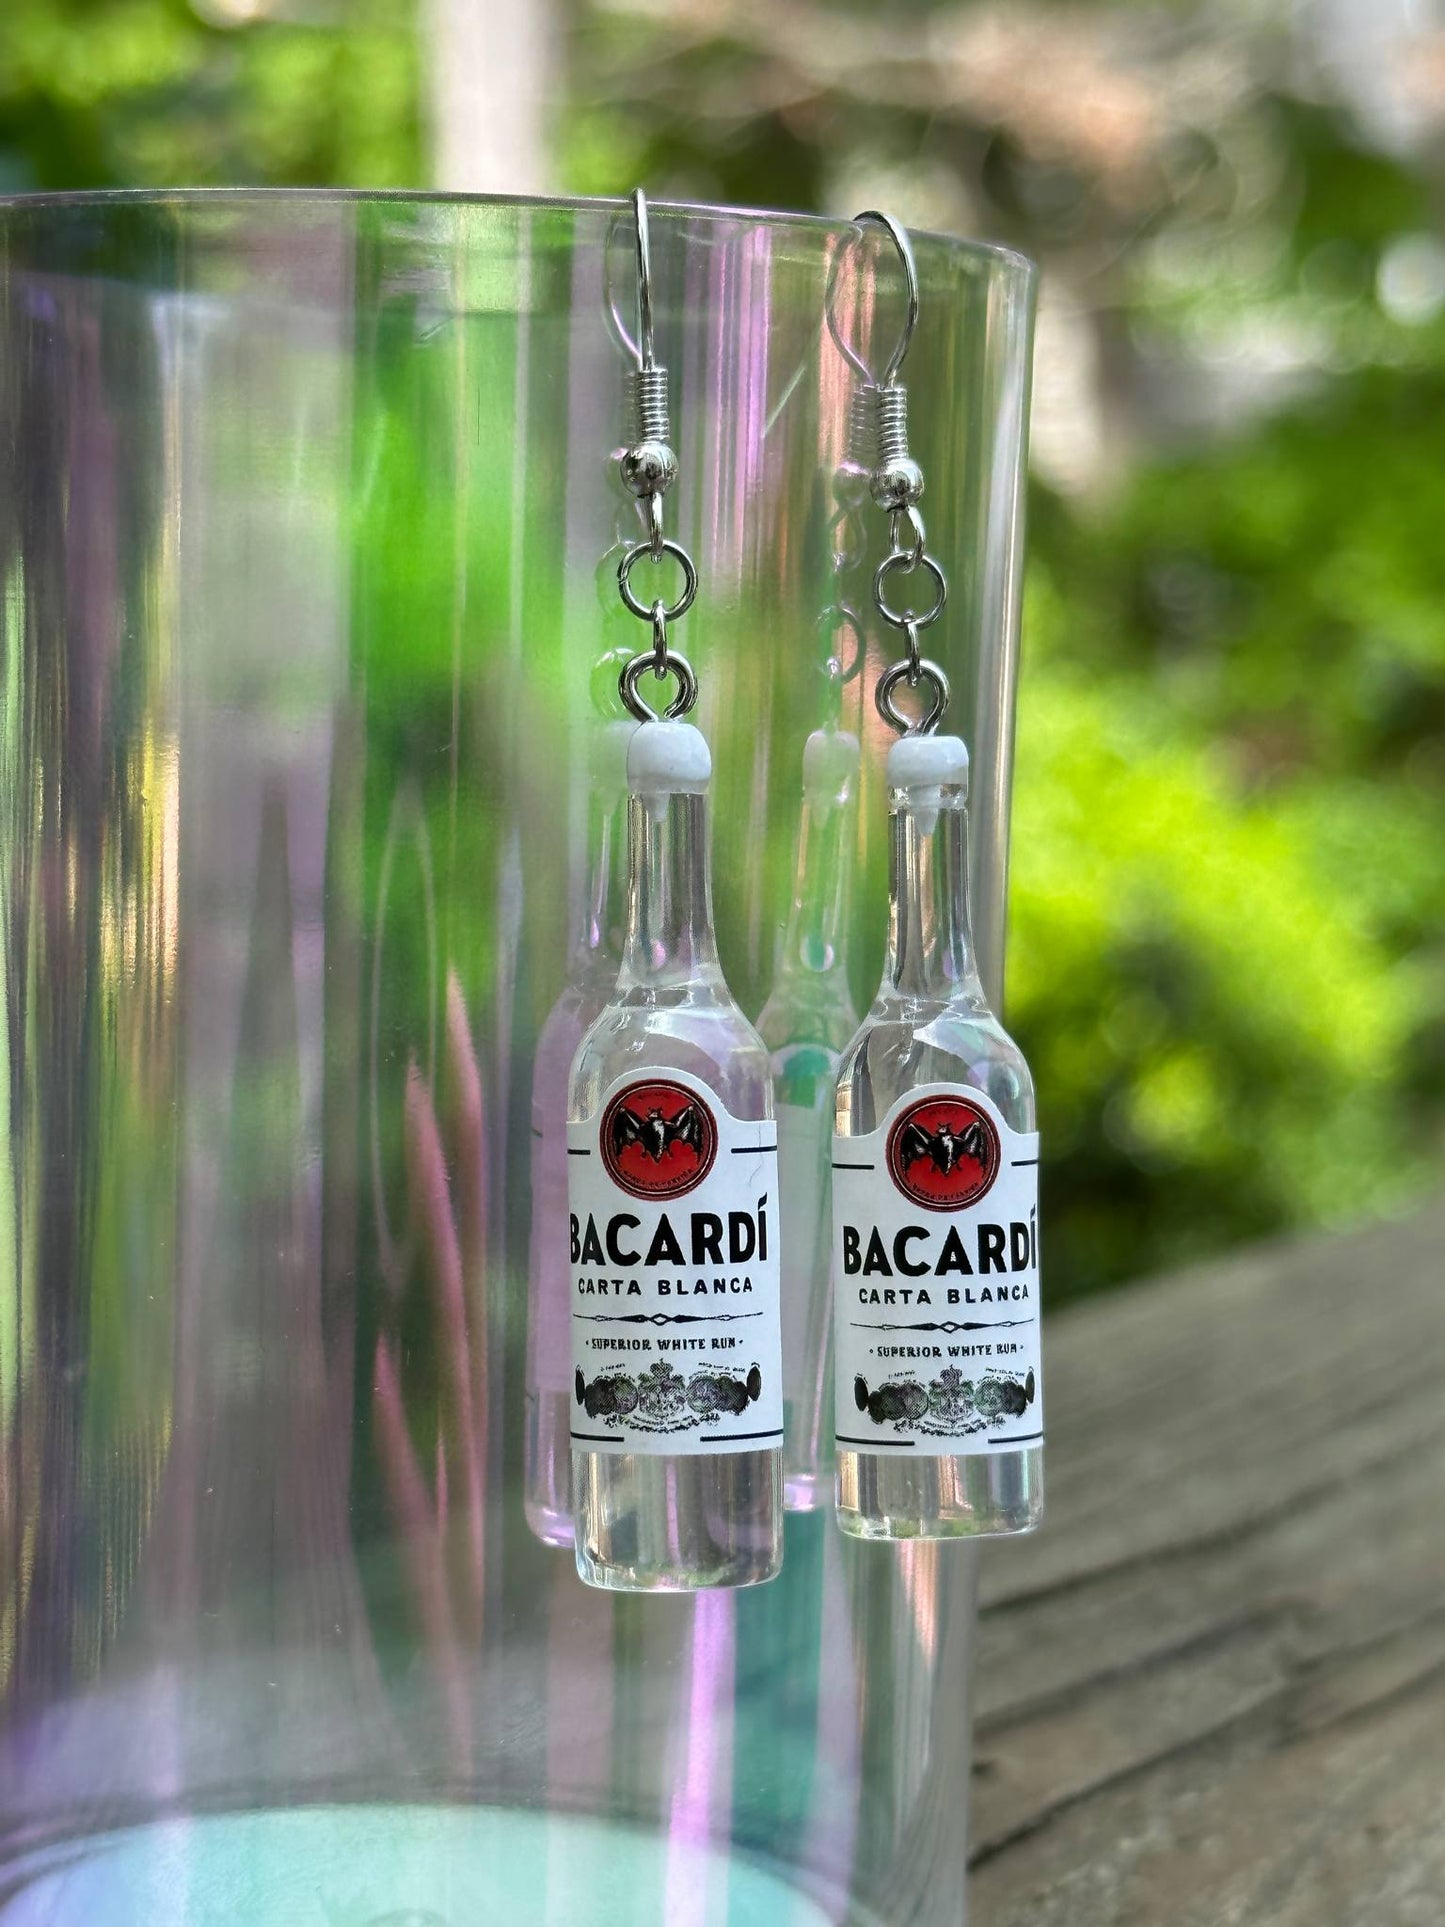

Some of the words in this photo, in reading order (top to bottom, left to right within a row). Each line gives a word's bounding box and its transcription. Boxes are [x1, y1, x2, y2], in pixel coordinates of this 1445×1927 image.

[570, 1192, 767, 1266] BACARDÍ
[843, 1204, 1036, 1276] BACARDÍ
[578, 1278, 642, 1295] CARTA
[658, 1277, 753, 1295] BLANCA
[858, 1288, 932, 1305] CARTA
[947, 1284, 1029, 1304] BLANCA
[591, 1338, 652, 1351] SUPERIOR
[656, 1338, 706, 1350] WHITE
[877, 1345, 942, 1358] SUPERIOR
[947, 1344, 993, 1357] WHITE
